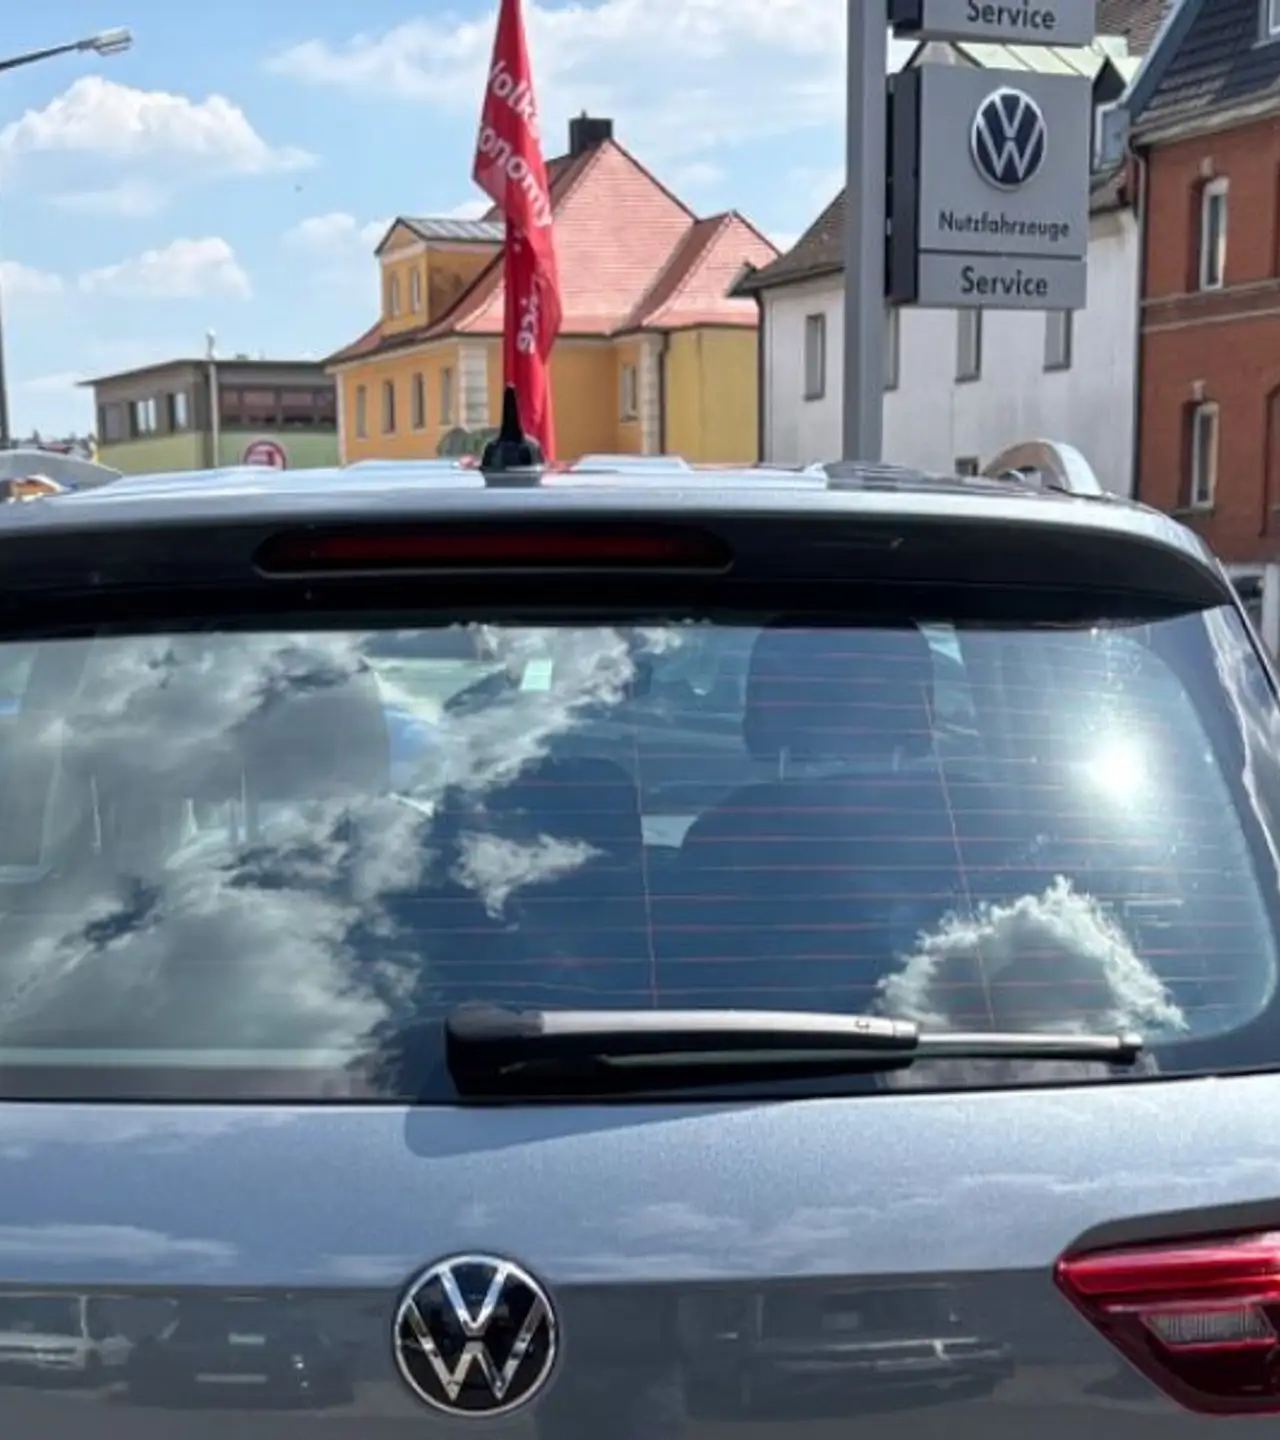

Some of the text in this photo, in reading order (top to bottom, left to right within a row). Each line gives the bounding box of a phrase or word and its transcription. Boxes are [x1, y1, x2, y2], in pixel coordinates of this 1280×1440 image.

[966, 0, 1057, 29] Service
[938, 210, 1070, 242] Nutzfahrzeuge
[960, 265, 1048, 297] Service
[393, 1254, 556, 1417] VW
